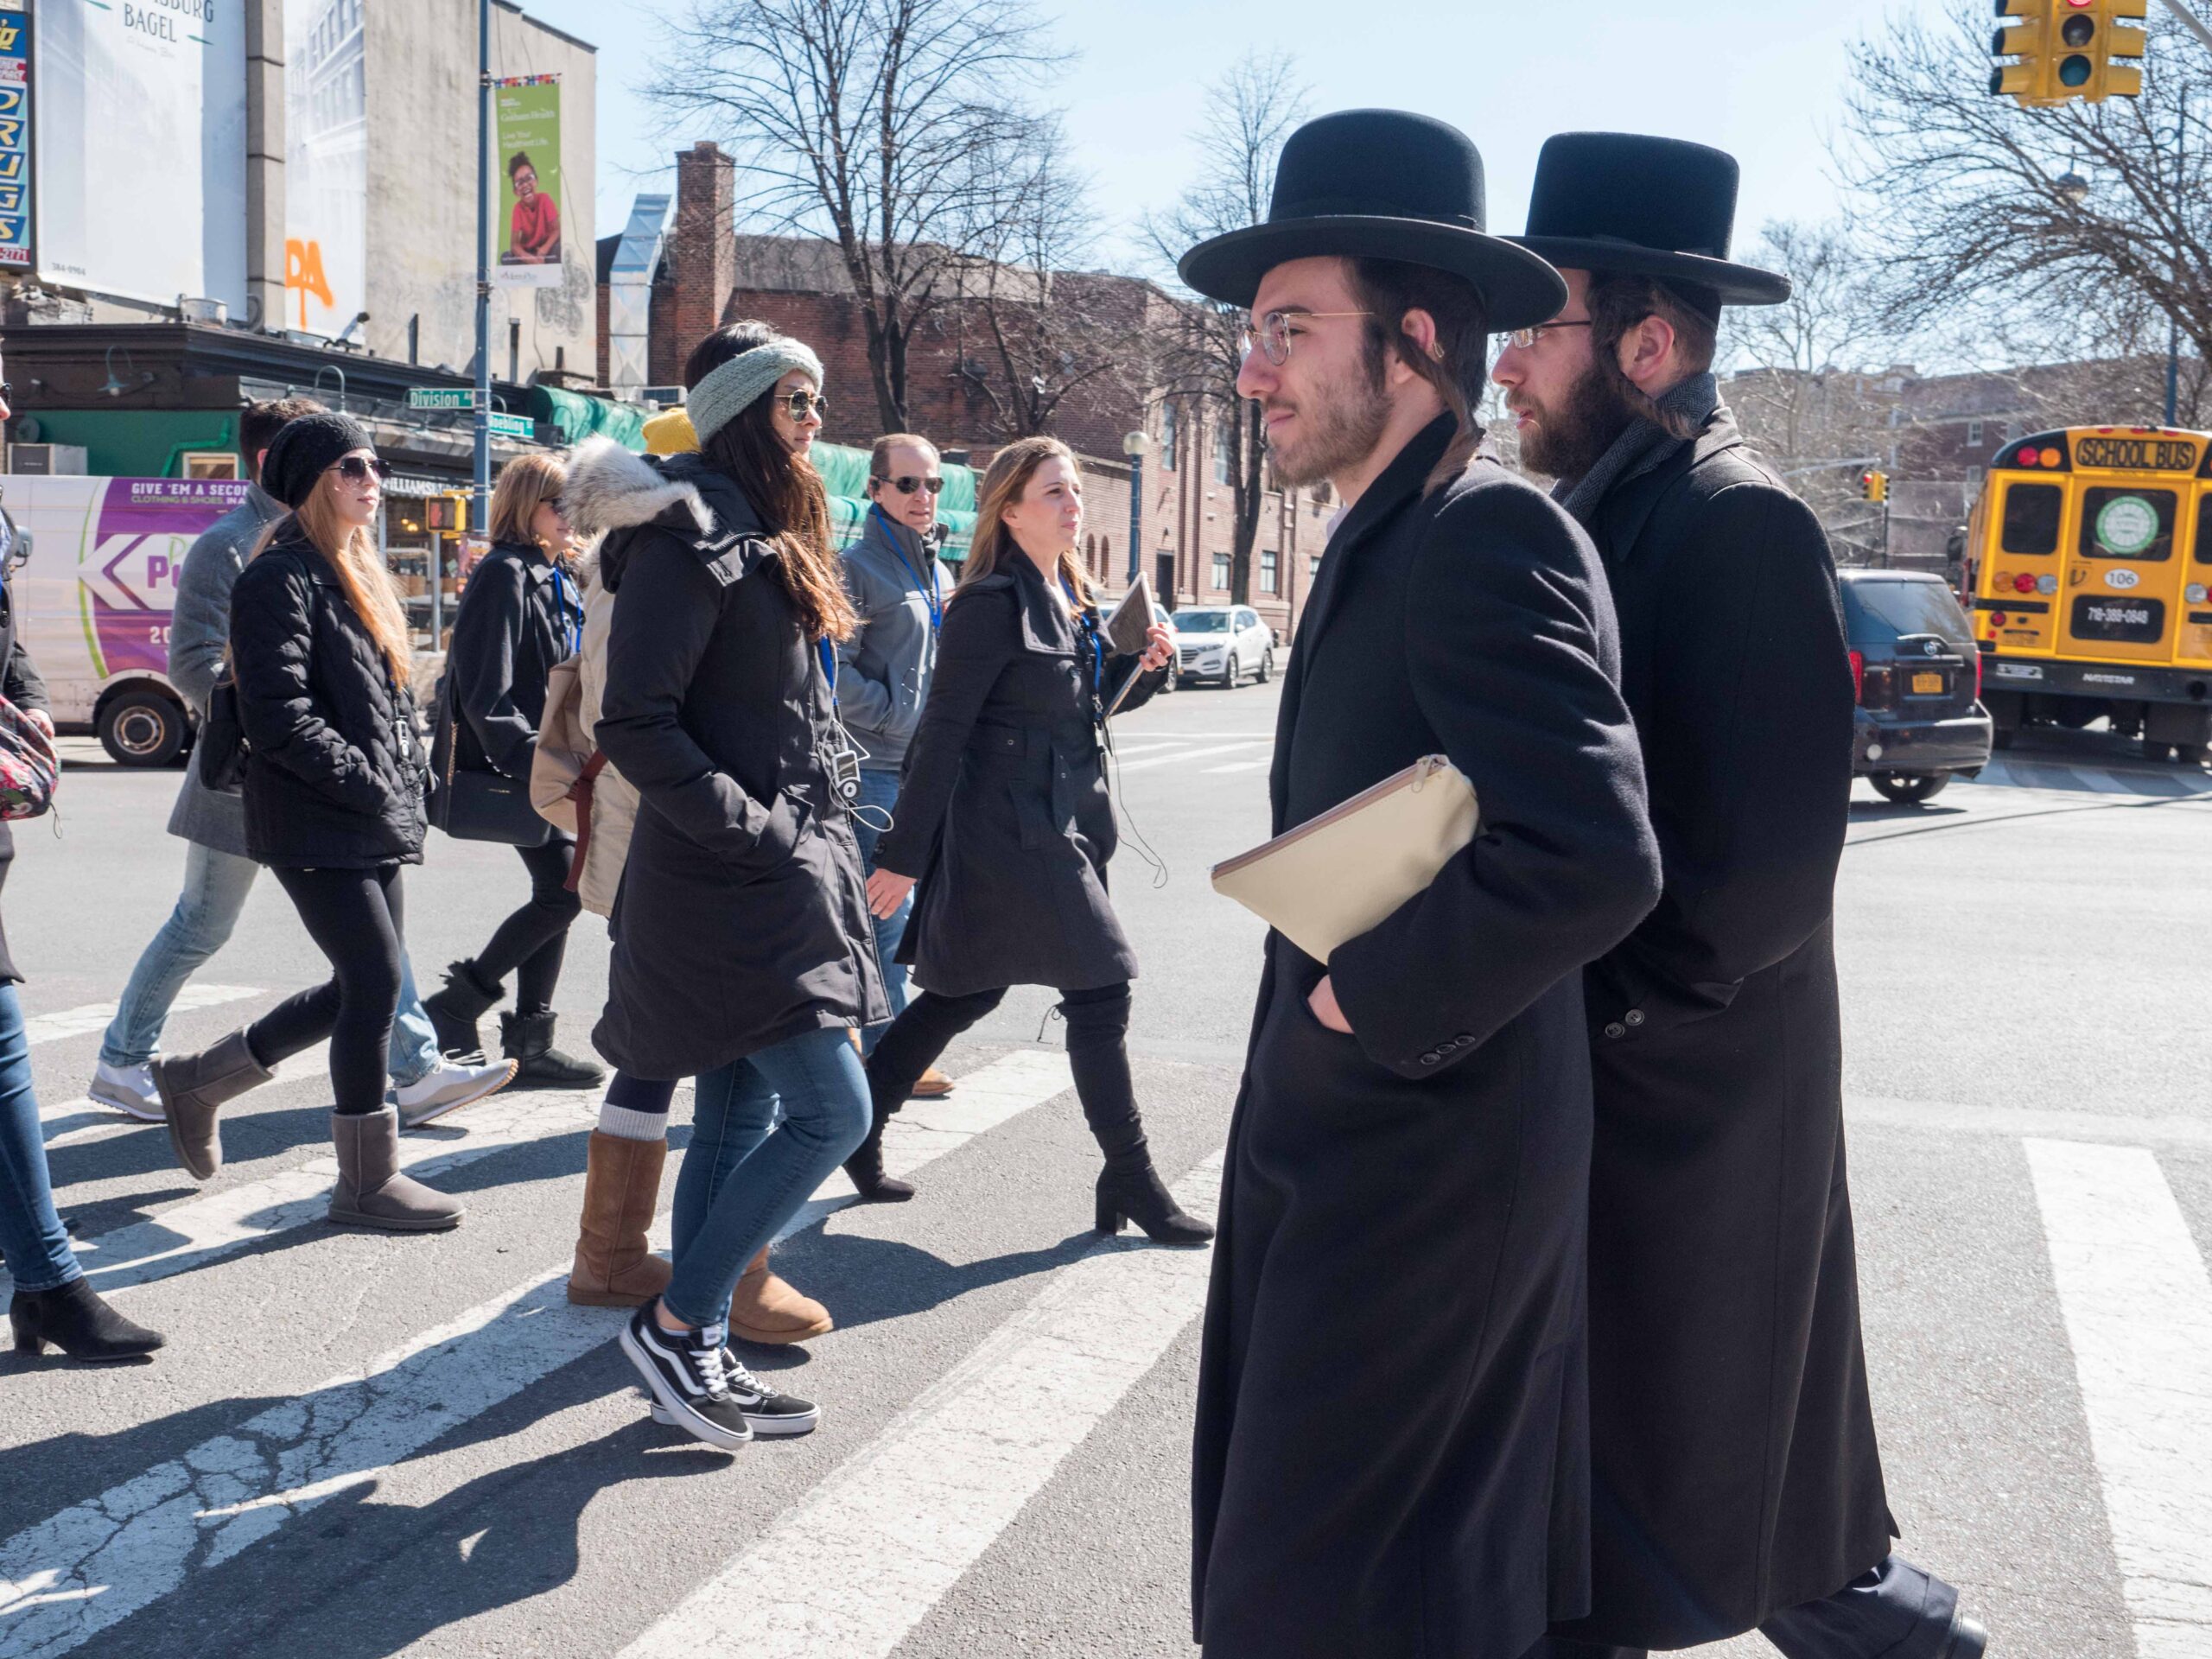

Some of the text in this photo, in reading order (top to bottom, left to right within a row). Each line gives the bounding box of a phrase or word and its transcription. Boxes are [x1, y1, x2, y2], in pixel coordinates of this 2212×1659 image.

[124, 3, 177, 42] BAGEL
[410, 391, 460, 407] Division
[2082, 438, 2191, 470] SCHOOL BUS
[131, 483, 162, 494] GIVE
[168, 484, 190, 495] 'EM
[195, 485, 204, 495] A
[131, 495, 179, 504] CLOTHING
[2109, 573, 2135, 585] 106
